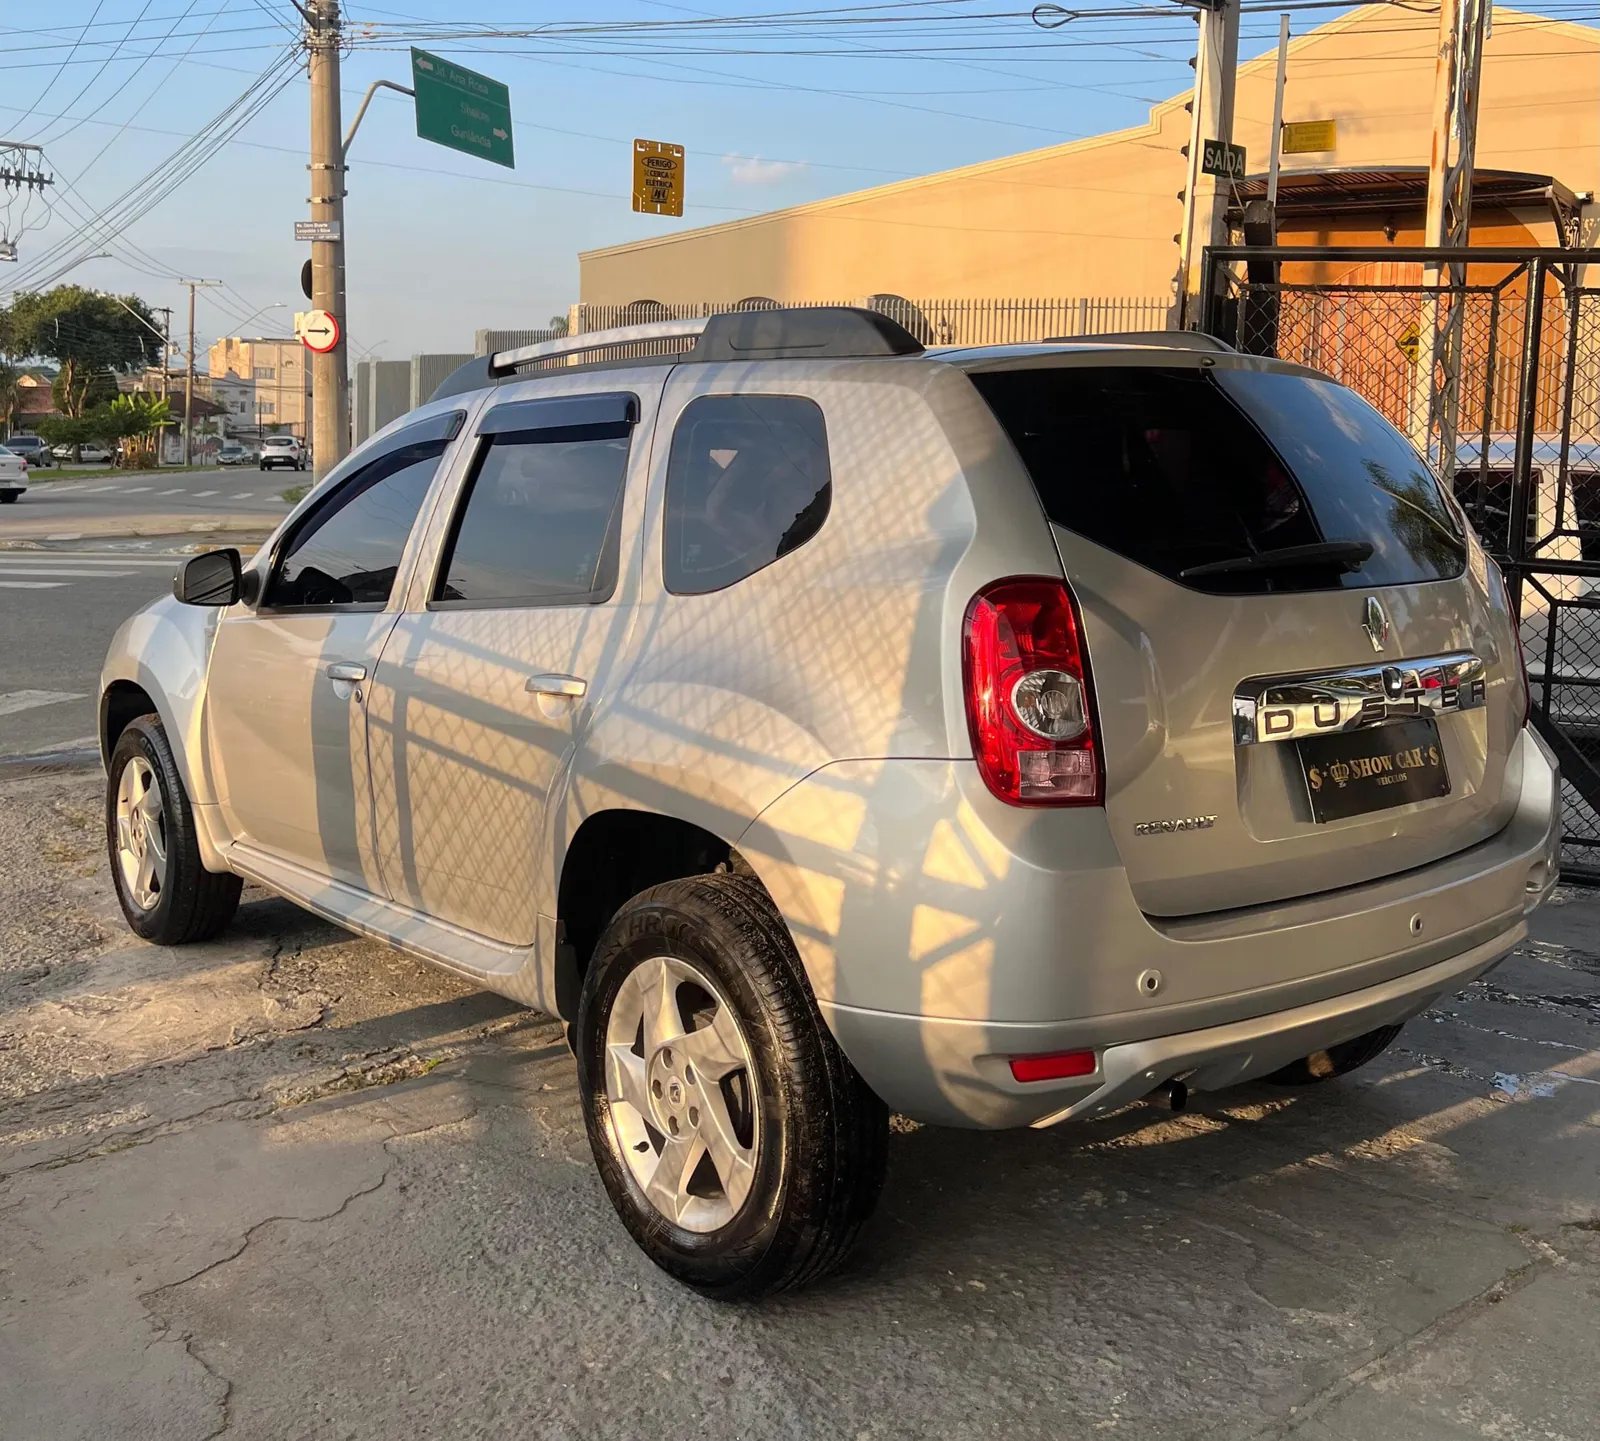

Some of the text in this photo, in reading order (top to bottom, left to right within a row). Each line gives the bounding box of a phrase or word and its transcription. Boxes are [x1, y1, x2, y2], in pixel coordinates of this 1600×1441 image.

[647, 158, 672, 168] PERIGO
[1204, 147, 1244, 174] SAÍDA
[650, 170, 669, 178] CERCA
[1265, 679, 1485, 734] DUSTER
[1349, 754, 1393, 780] SHOW
[1134, 814, 1218, 836] RENAULT
